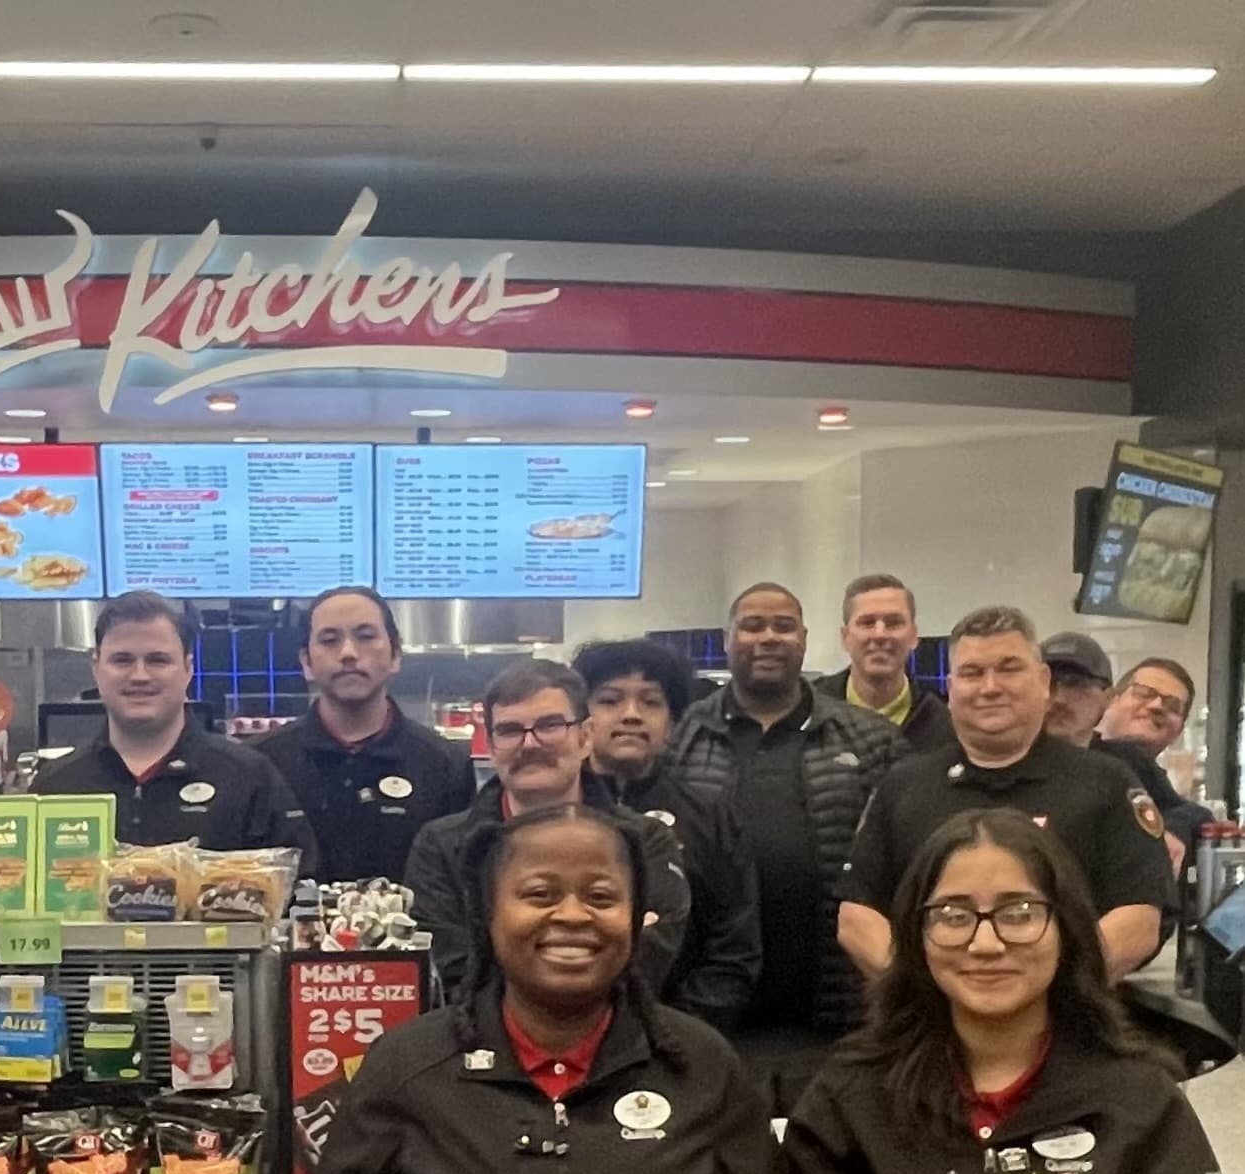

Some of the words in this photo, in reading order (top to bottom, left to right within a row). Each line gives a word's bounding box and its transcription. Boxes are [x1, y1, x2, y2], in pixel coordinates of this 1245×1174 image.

[99, 187, 559, 414] Kitchens
[10, 938, 51, 951] 17.99
[300, 964, 375, 983] M&M's
[300, 986, 368, 1002] SHARE
[371, 985, 415, 1001] SIZE
[308, 1008, 329, 1033] 2
[333, 1008, 384, 1043] $5
